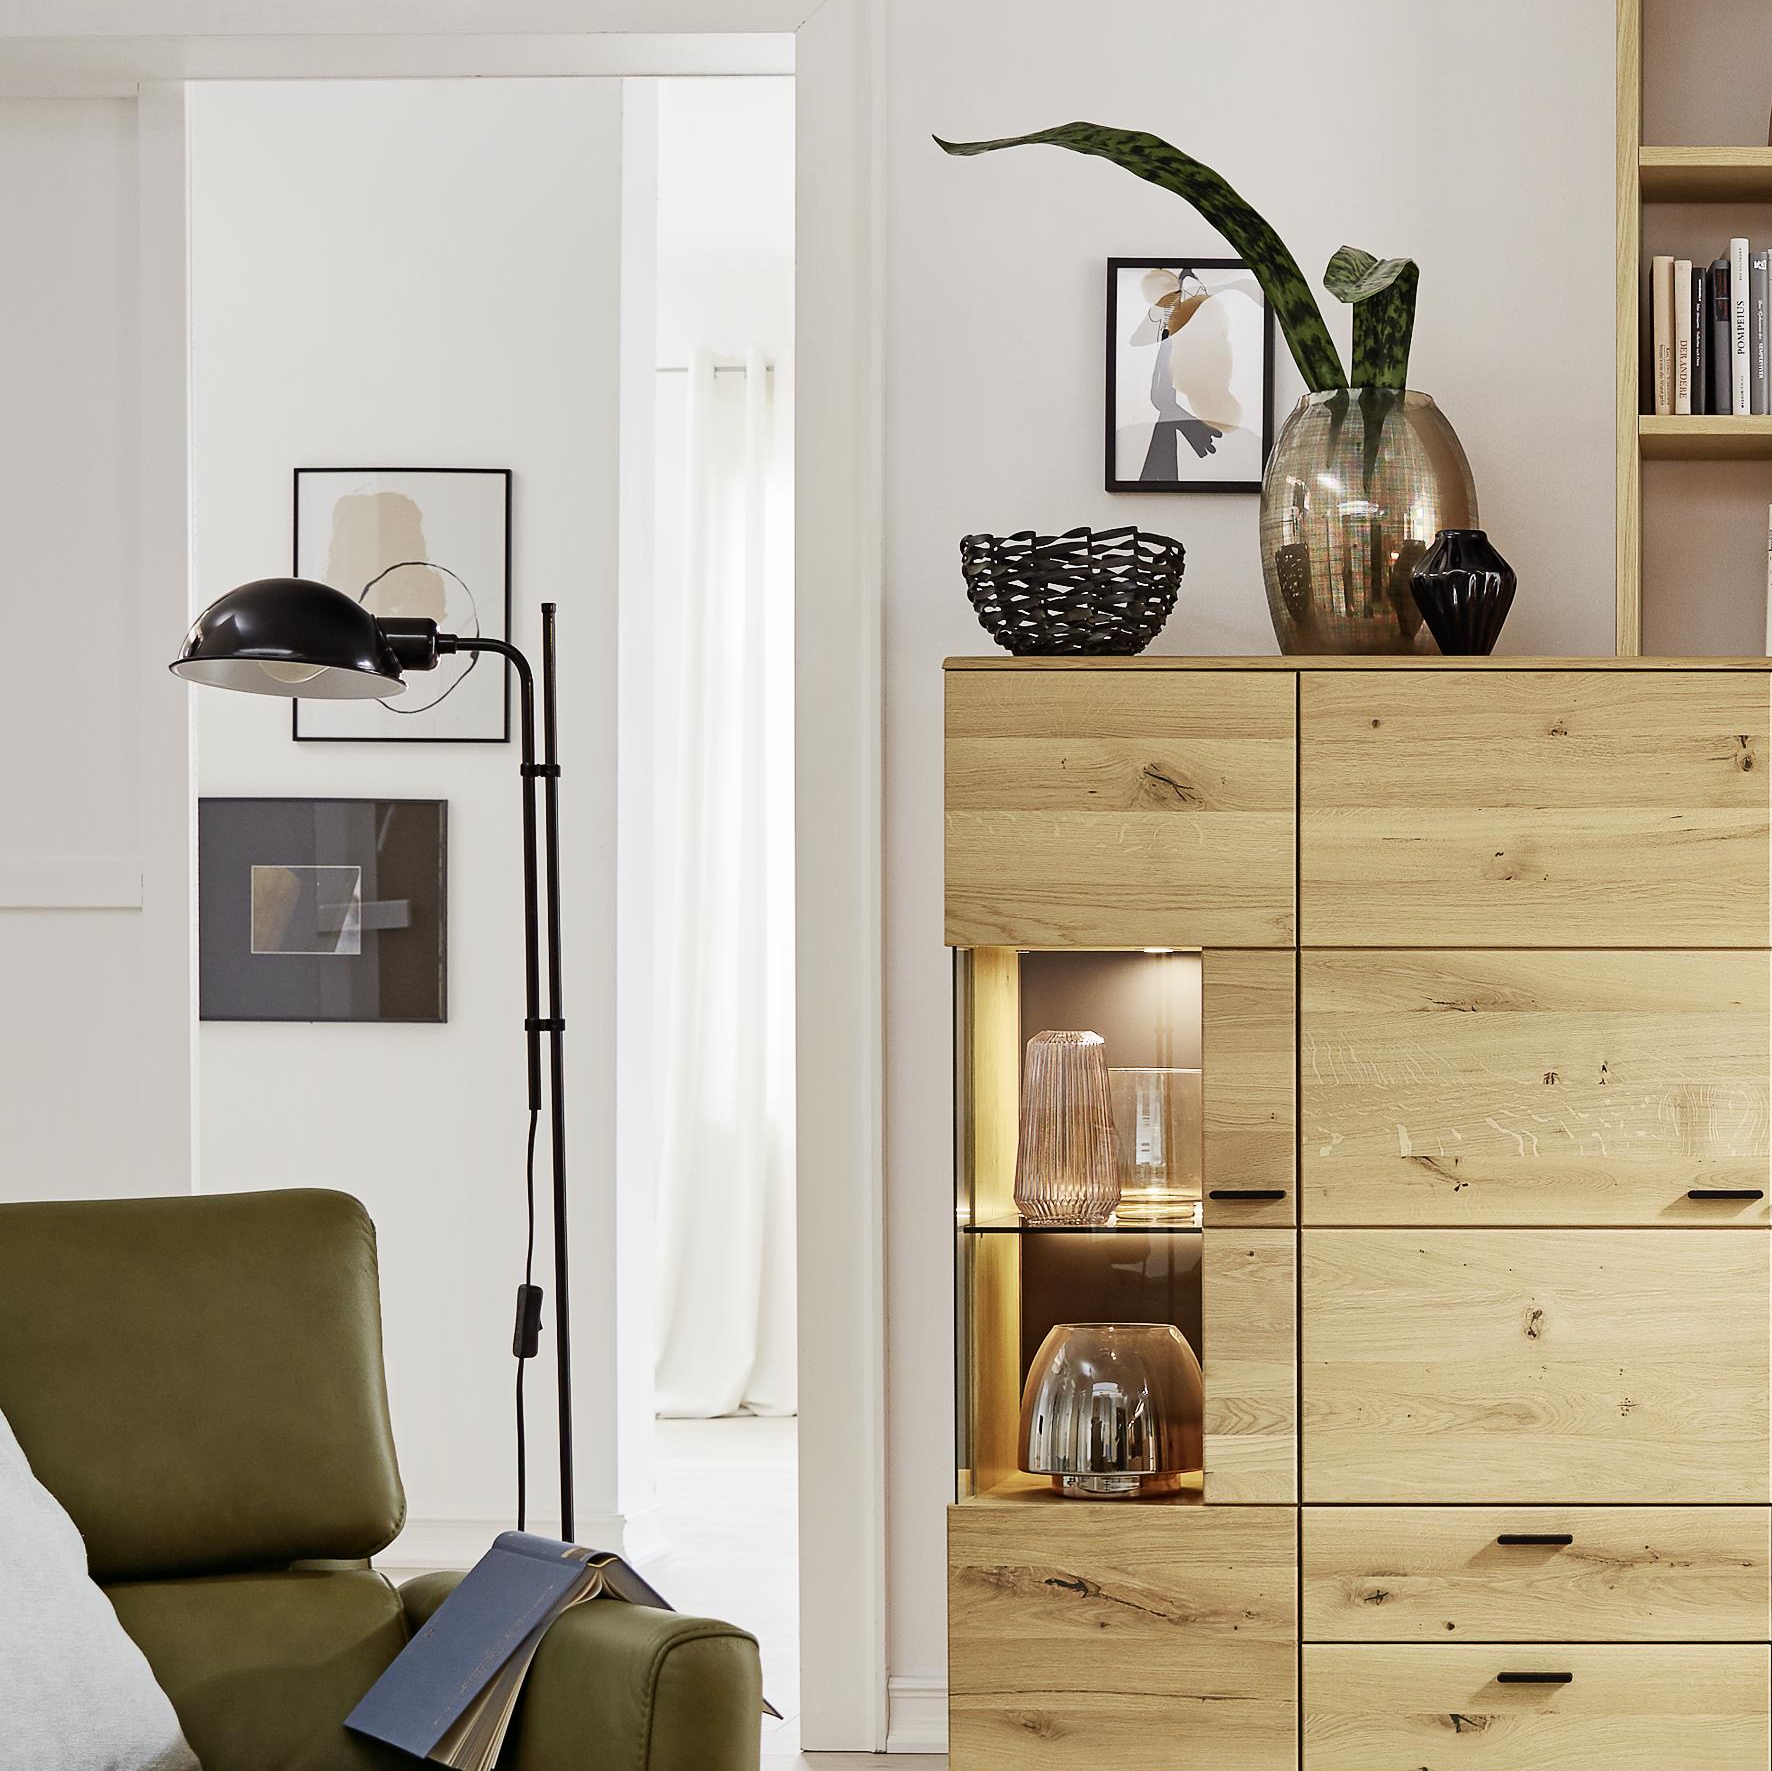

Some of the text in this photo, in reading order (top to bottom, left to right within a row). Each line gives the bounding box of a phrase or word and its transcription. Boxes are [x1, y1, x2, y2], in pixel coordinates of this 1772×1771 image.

[1736, 300, 1746, 355] POMPEIUS
[1679, 339, 1688, 399] DER ANDERE
